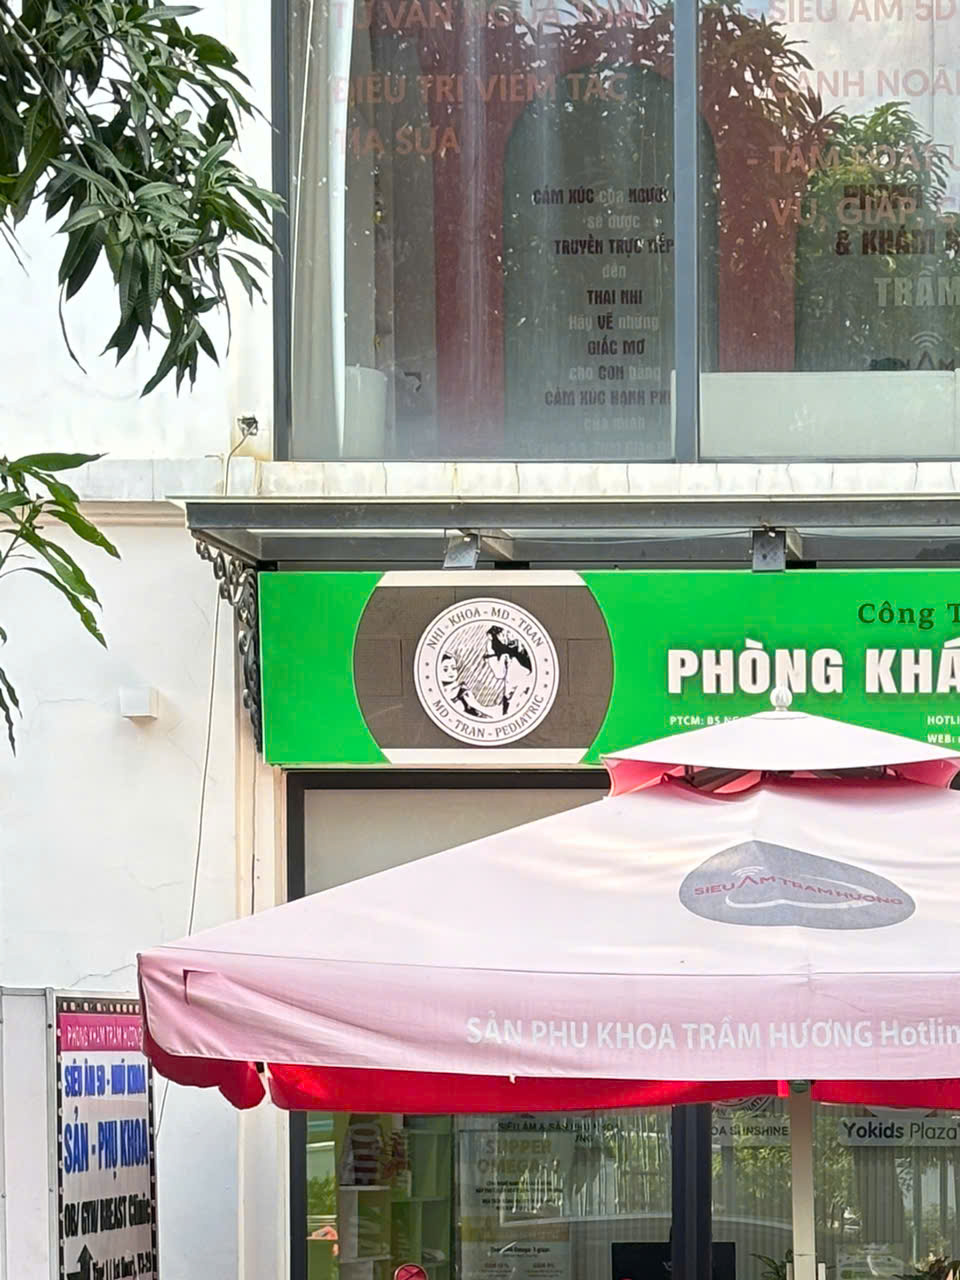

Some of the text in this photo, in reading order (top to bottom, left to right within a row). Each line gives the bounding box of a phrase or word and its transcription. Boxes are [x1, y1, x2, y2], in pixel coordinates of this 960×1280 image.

[586, 289, 643, 305] THAI NHI
[587, 334, 618, 356] GIÁC
[598, 365, 624, 381] CON
[426, 607, 546, 651] NHI KHOA MD TRAN
[857, 602, 935, 630] Công
[667, 637, 844, 694] PHÒNG
[432, 695, 545, 739] MD TRAN PEDIATRIC
[465, 1010, 523, 1045] SẢN
[596, 1022, 676, 1050] KHOA
[768, 1016, 873, 1048] HƯƠNG
[120, 1118, 149, 1168] KHOA
[842, 1119, 959, 1141] Yokids Plaza
